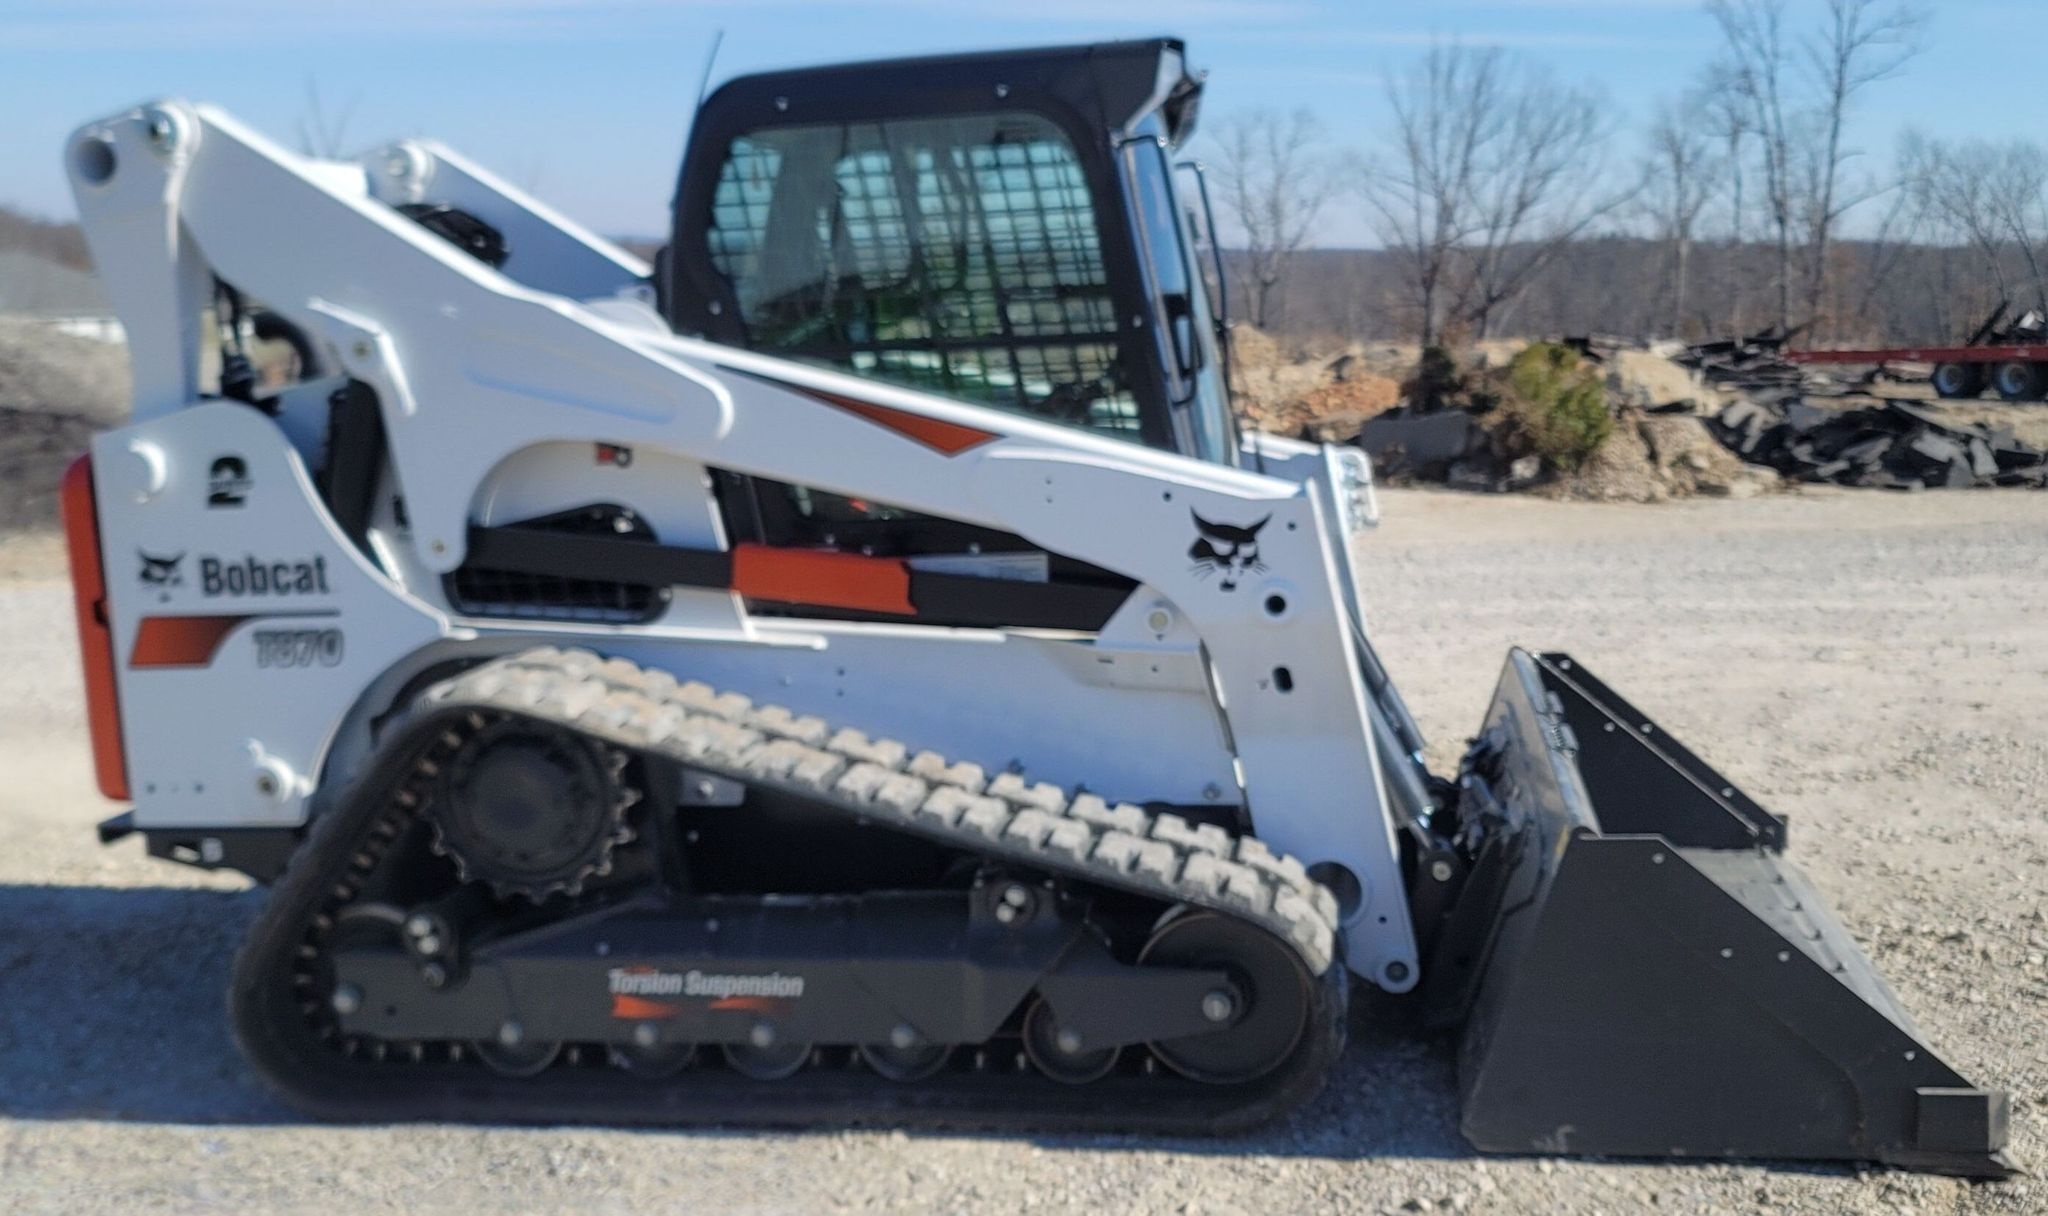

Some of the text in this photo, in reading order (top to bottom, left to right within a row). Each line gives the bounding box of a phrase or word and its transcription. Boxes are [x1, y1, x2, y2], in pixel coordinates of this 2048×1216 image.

[208, 456, 247, 508] 2
[200, 555, 330, 596] Bobcat
[252, 628, 345, 669] T870
[609, 968, 804, 999] Torsion Suspension
